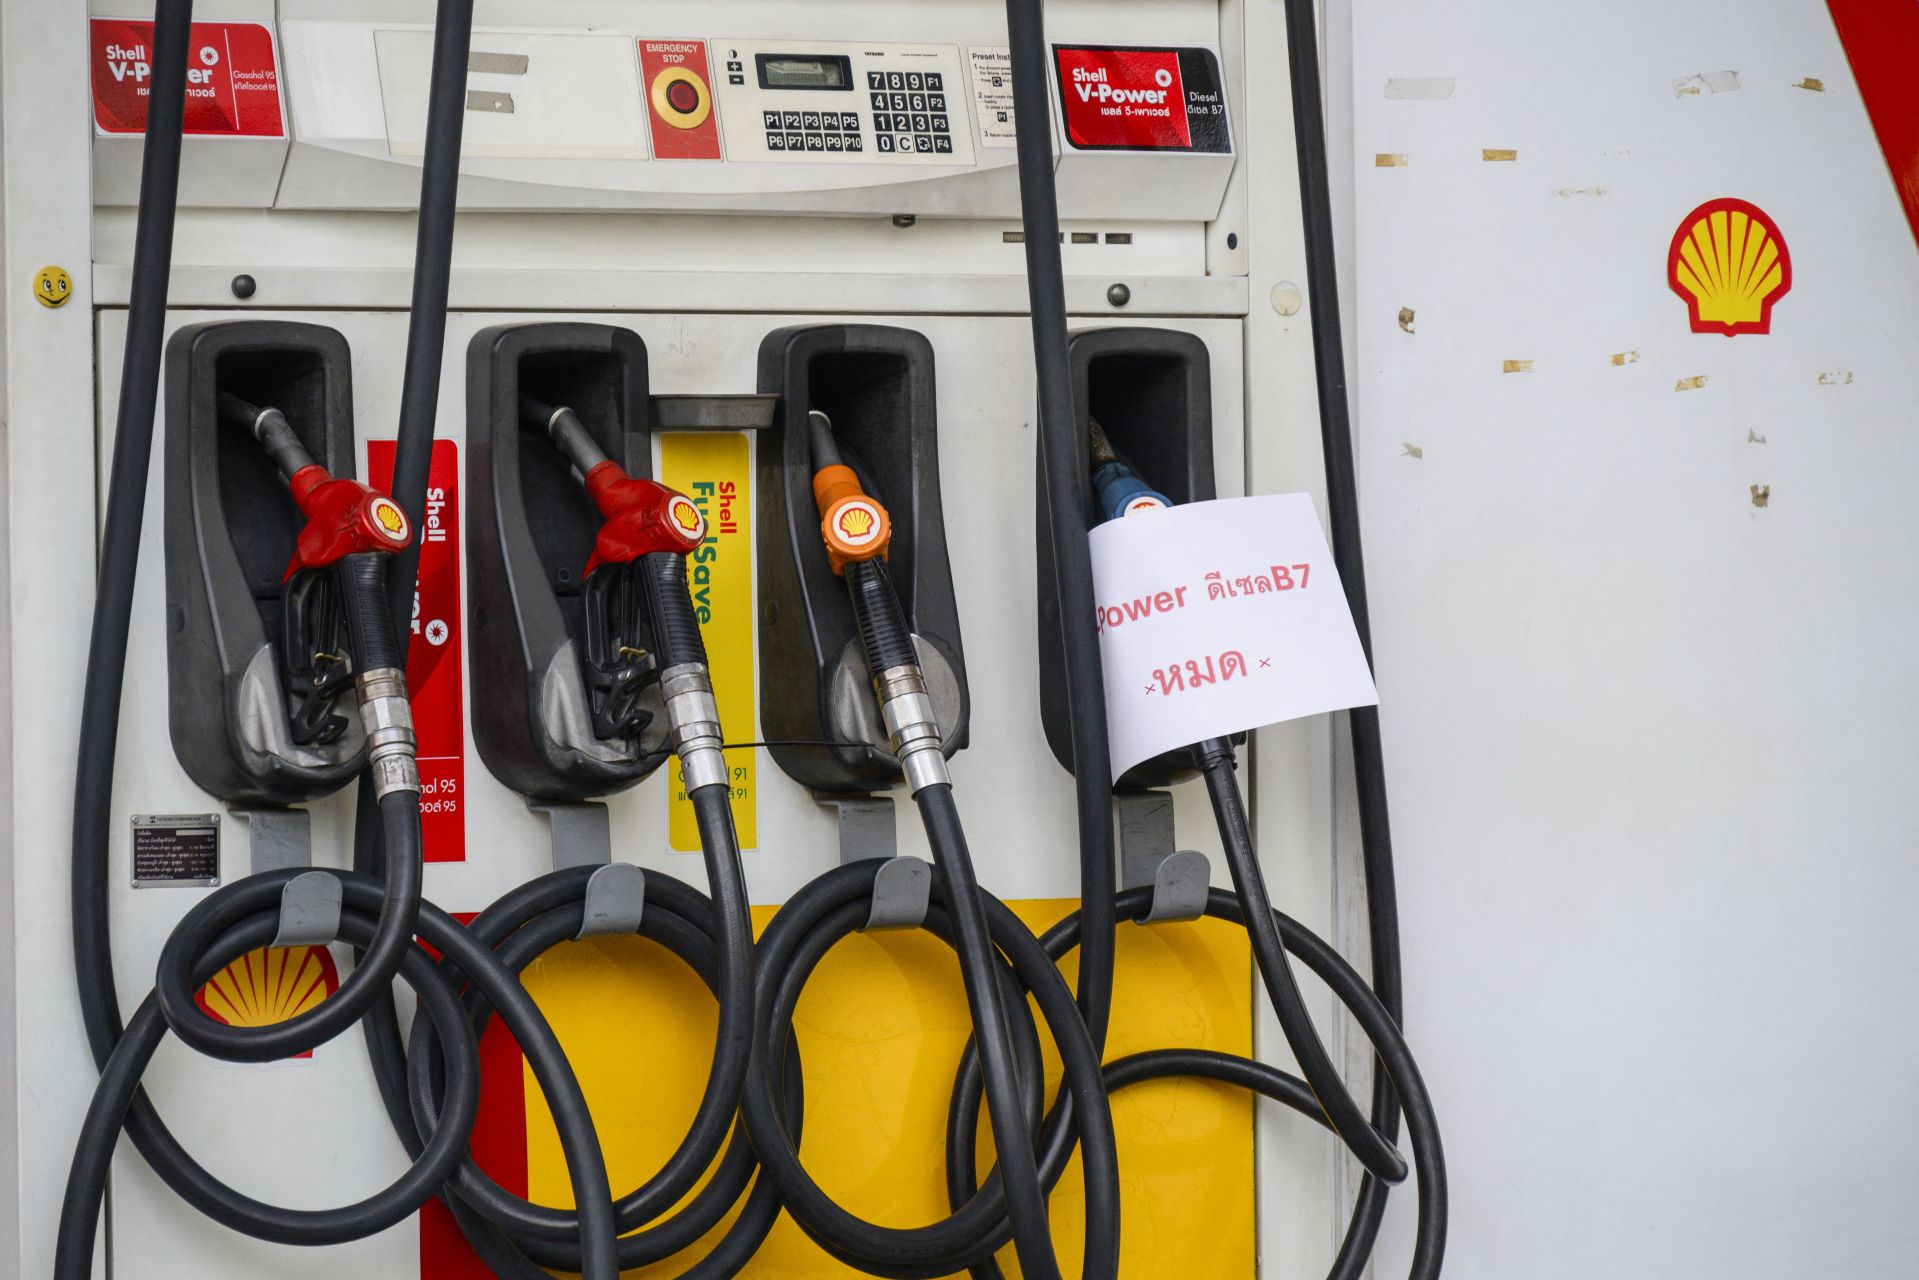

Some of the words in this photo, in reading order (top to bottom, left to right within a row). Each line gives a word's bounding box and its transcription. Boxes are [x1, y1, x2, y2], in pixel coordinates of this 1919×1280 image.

[106, 44, 146, 60] Shell
[646, 44, 698, 53] EMERGENCY
[662, 54, 685, 63] STOP
[107, 62, 213, 84] V-Per
[233, 70, 264, 80] Gasohol
[264, 71, 275, 80] 95
[1072, 68, 1108, 82] Shell
[871, 74, 881, 88] 7
[891, 74, 901, 88] 8
[910, 75, 920, 89] 9
[928, 77, 939, 87] F1
[1074, 83, 1167, 104] V-Power
[1190, 91, 1218, 102] Diesel
[875, 95, 884, 108] 4
[894, 96, 904, 110] 5
[913, 96, 922, 110] 6
[930, 98, 943, 108] F2
[1126, 106, 1170, 117] วี-เพาเวอร์
[1212, 105, 1224, 115] B7
[766, 114, 780, 126] P1
[785, 115, 800, 126] P2
[804, 116, 819, 126] P3
[824, 116, 838, 127] P4
[842, 116, 858, 127] P5
[878, 116, 886, 130] 1
[896, 116, 907, 130] 2
[916, 116, 926, 130] 3
[934, 119, 946, 128] F3
[768, 136, 784, 147] P6
[788, 136, 802, 147] P7
[807, 136, 822, 148] P8
[826, 137, 840, 148] P9
[844, 137, 862, 148] P10
[880, 136, 890, 150] 0
[900, 137, 910, 150] C
[936, 140, 950, 149] F4
[426, 487, 446, 542] Shell
[718, 481, 738, 534] Shell
[692, 481, 718, 625] FulSave
[1204, 563, 1310, 600] ดีเซลB7
[1152, 650, 1248, 696] หมด
[734, 767, 747, 780] 91
[440, 779, 456, 794] 95
[736, 788, 747, 800] 91
[443, 800, 456, 813] 95
